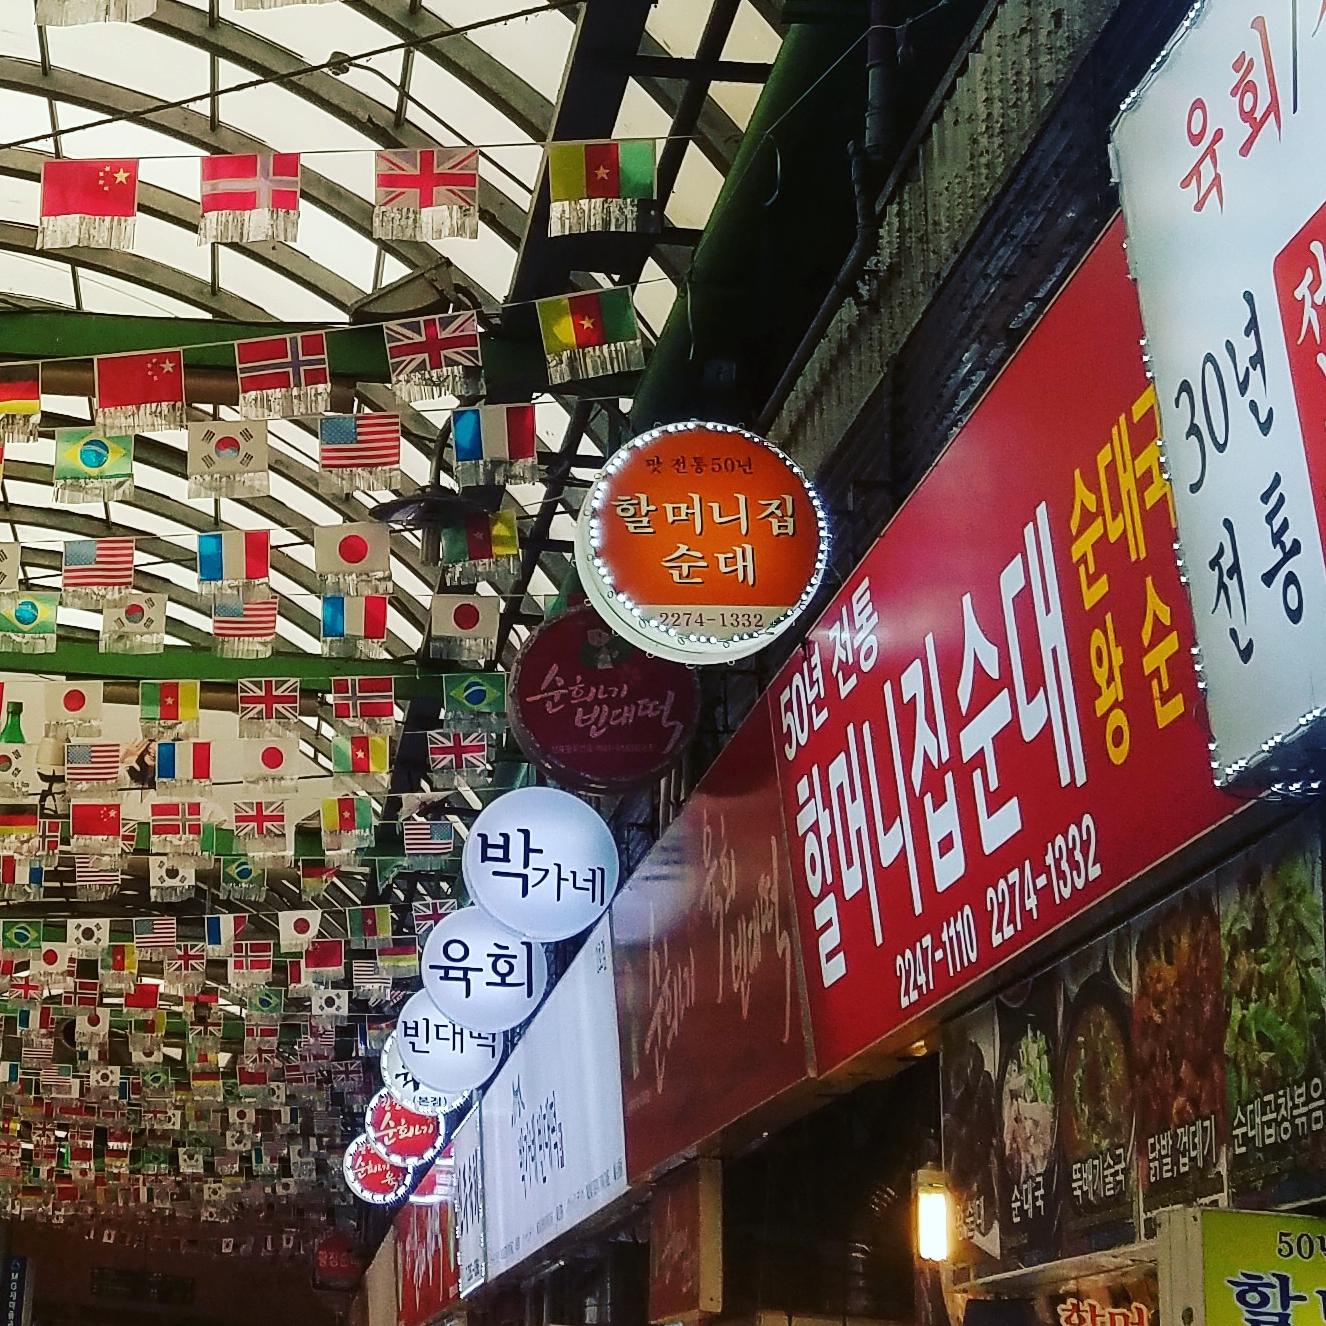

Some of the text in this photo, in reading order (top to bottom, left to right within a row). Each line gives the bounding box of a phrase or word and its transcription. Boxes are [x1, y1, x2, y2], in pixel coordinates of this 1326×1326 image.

[1179, 15, 1282, 215] 육회
[1174, 290, 1275, 494] 30년
[645, 455, 663, 474] 맛
[612, 493, 795, 538] 할머니집
[662, 543, 757, 586] 순대
[1211, 471, 1305, 665] 전통
[658, 611, 765, 629] 2274-1332
[779, 576, 878, 761] 50년 전통
[575, 691, 684, 754] 빈대떡
[795, 500, 1087, 989] 할머니집순대
[477, 828, 606, 906] 박가네
[894, 814, 1102, 1010] 2247-1110 2274-1332
[429, 939, 533, 998] 육회
[1011, 1177, 1045, 1223] 순대국
